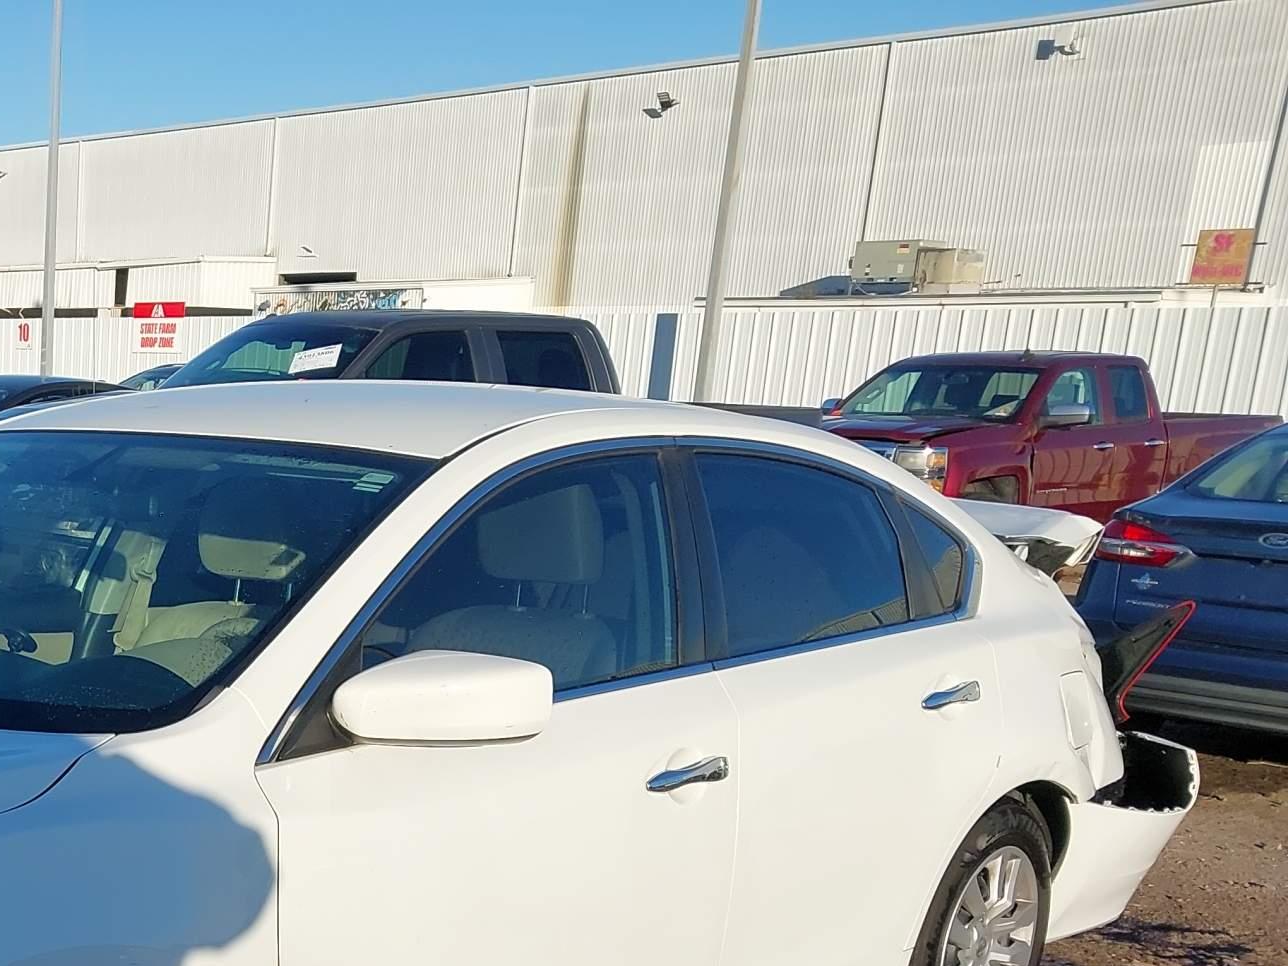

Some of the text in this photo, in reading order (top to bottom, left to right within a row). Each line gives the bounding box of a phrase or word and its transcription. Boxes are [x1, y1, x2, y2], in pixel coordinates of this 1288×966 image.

[18, 322, 30, 342] 10
[140, 322, 177, 335] STATE FARM
[140, 336, 175, 349] DROP ZONE
